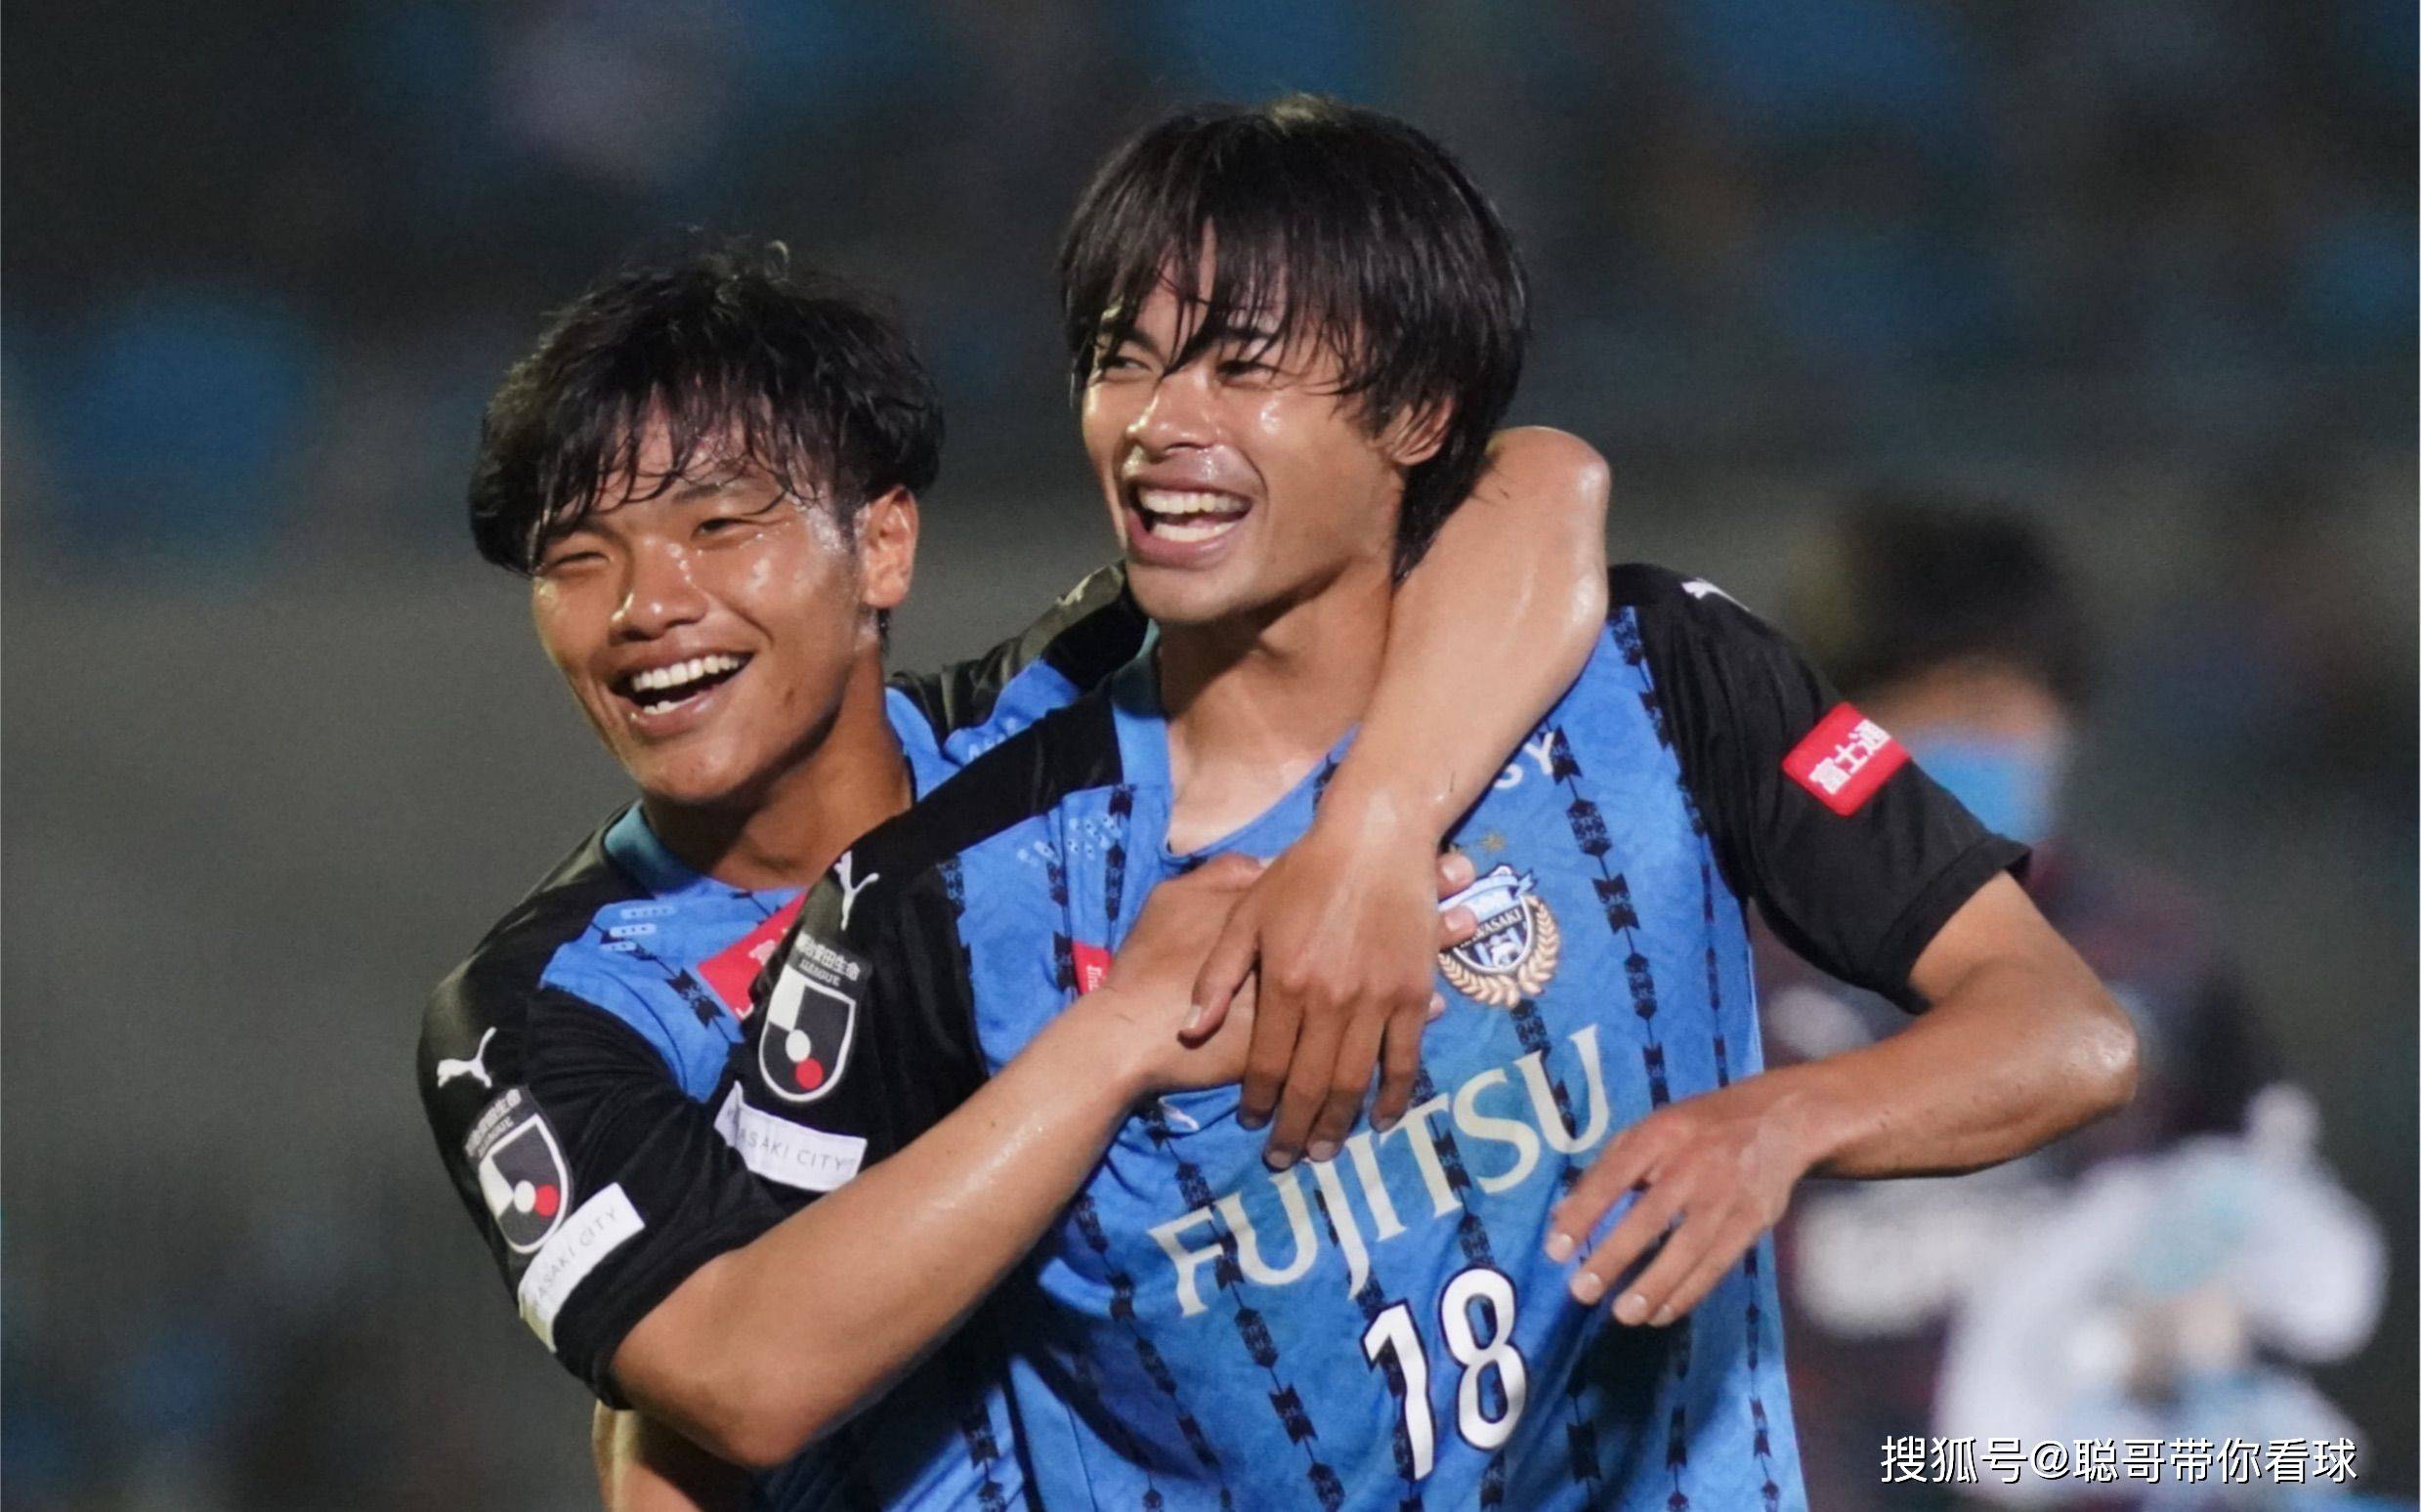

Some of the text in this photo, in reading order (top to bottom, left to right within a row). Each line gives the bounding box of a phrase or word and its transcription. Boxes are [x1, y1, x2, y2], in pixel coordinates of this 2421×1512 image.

[1494, 732, 1554, 788] SY
[1460, 908, 1522, 946] WASAKI
[796, 1149, 846, 1170] CITY
[1148, 1024, 1609, 1317] FUJITSU
[537, 1206, 617, 1299] ASAKI CITY
[1360, 1268, 1527, 1481] 18
